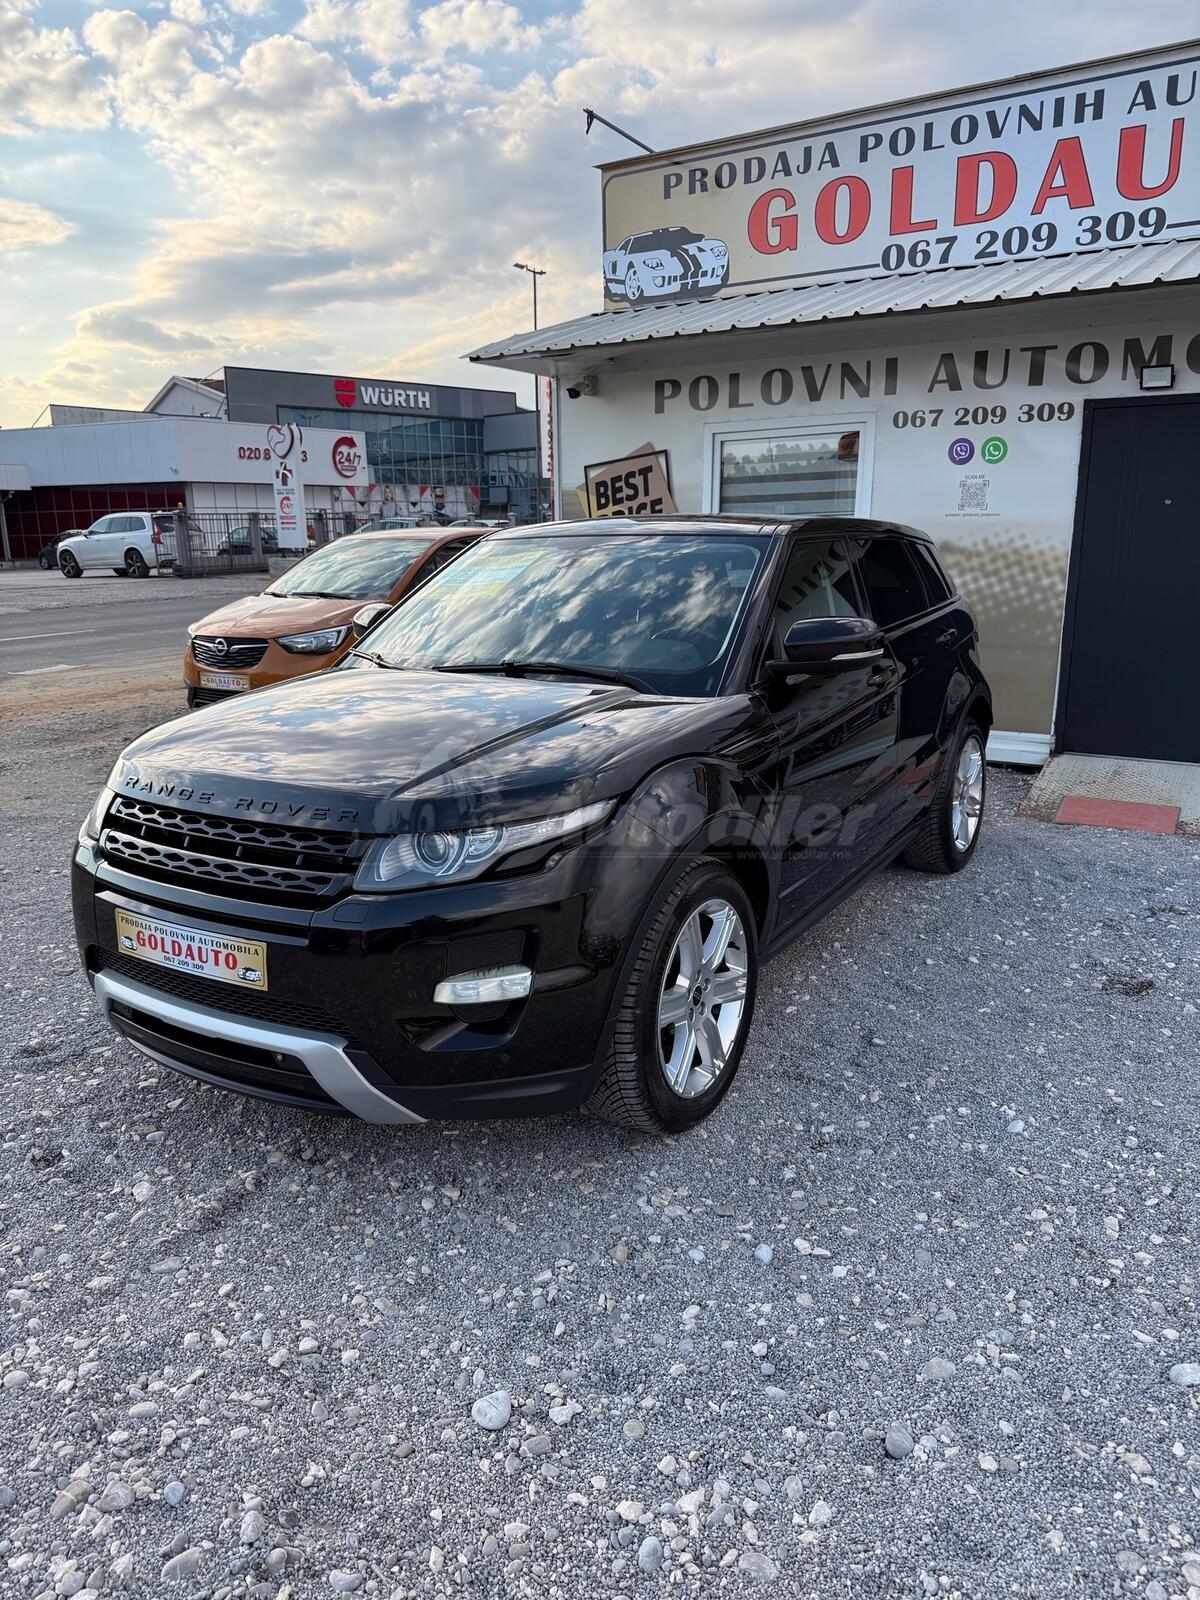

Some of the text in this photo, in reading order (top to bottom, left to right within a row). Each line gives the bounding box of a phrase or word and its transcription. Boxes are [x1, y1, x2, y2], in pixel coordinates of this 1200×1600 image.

[662, 140, 840, 200] PRODAJA
[859, 88, 1106, 163] POLOVNIH
[880, 206, 1167, 272] 067 209 309
[360, 385, 431, 410] WÜRTH
[654, 356, 899, 415] POLOVNI
[892, 401, 1075, 430] 067 209 309
[238, 446, 261, 460] 020
[337, 450, 362, 466] 24/7
[595, 464, 653, 511] BEST
[207, 678, 240, 686] GOLDAUTO
[124, 775, 360, 824] RANGE ROVER
[120, 915, 260, 957] PRODAJA POLOVNIH AUTOMOBILA
[135, 930, 239, 971] GOLDAUTO
[163, 954, 204, 971] 067 209 309
